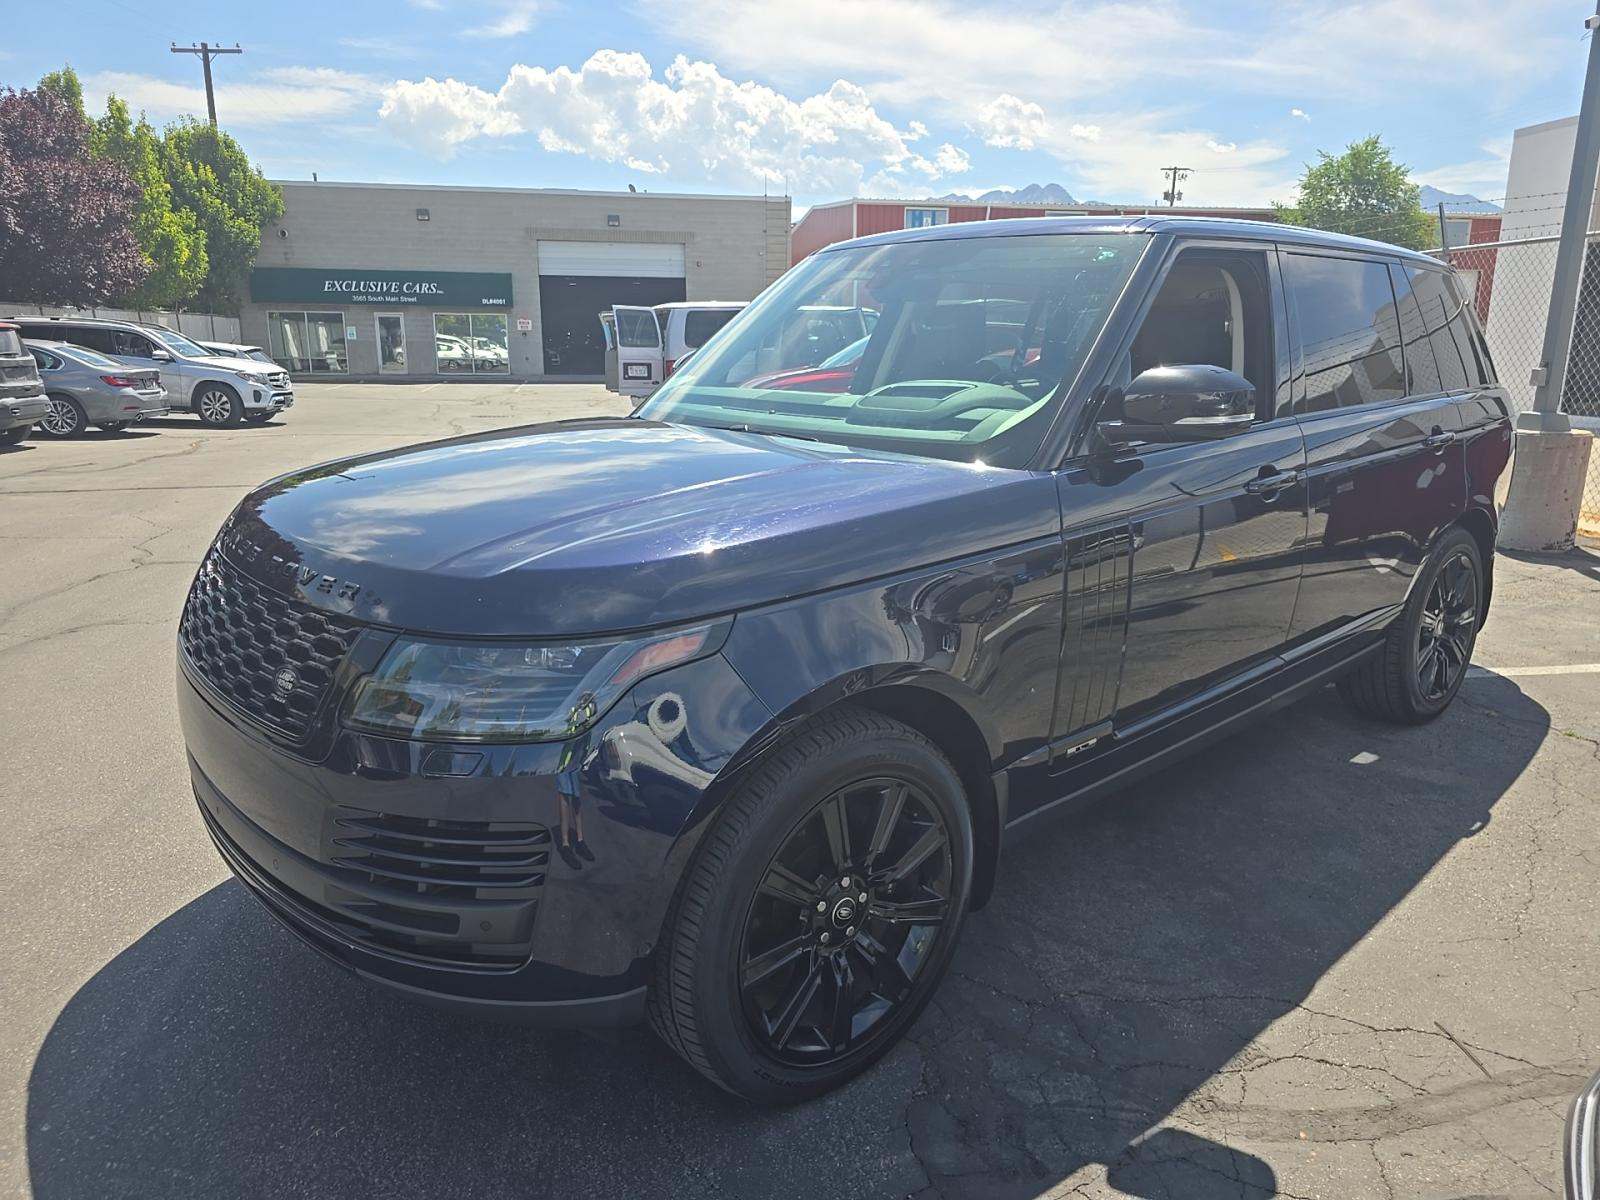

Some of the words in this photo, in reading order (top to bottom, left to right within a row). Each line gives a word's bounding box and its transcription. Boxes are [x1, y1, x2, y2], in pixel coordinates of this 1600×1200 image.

[323, 280, 400, 293] EXCLUSIVE
[402, 282, 438, 294] CARS
[399, 295, 417, 303] Street
